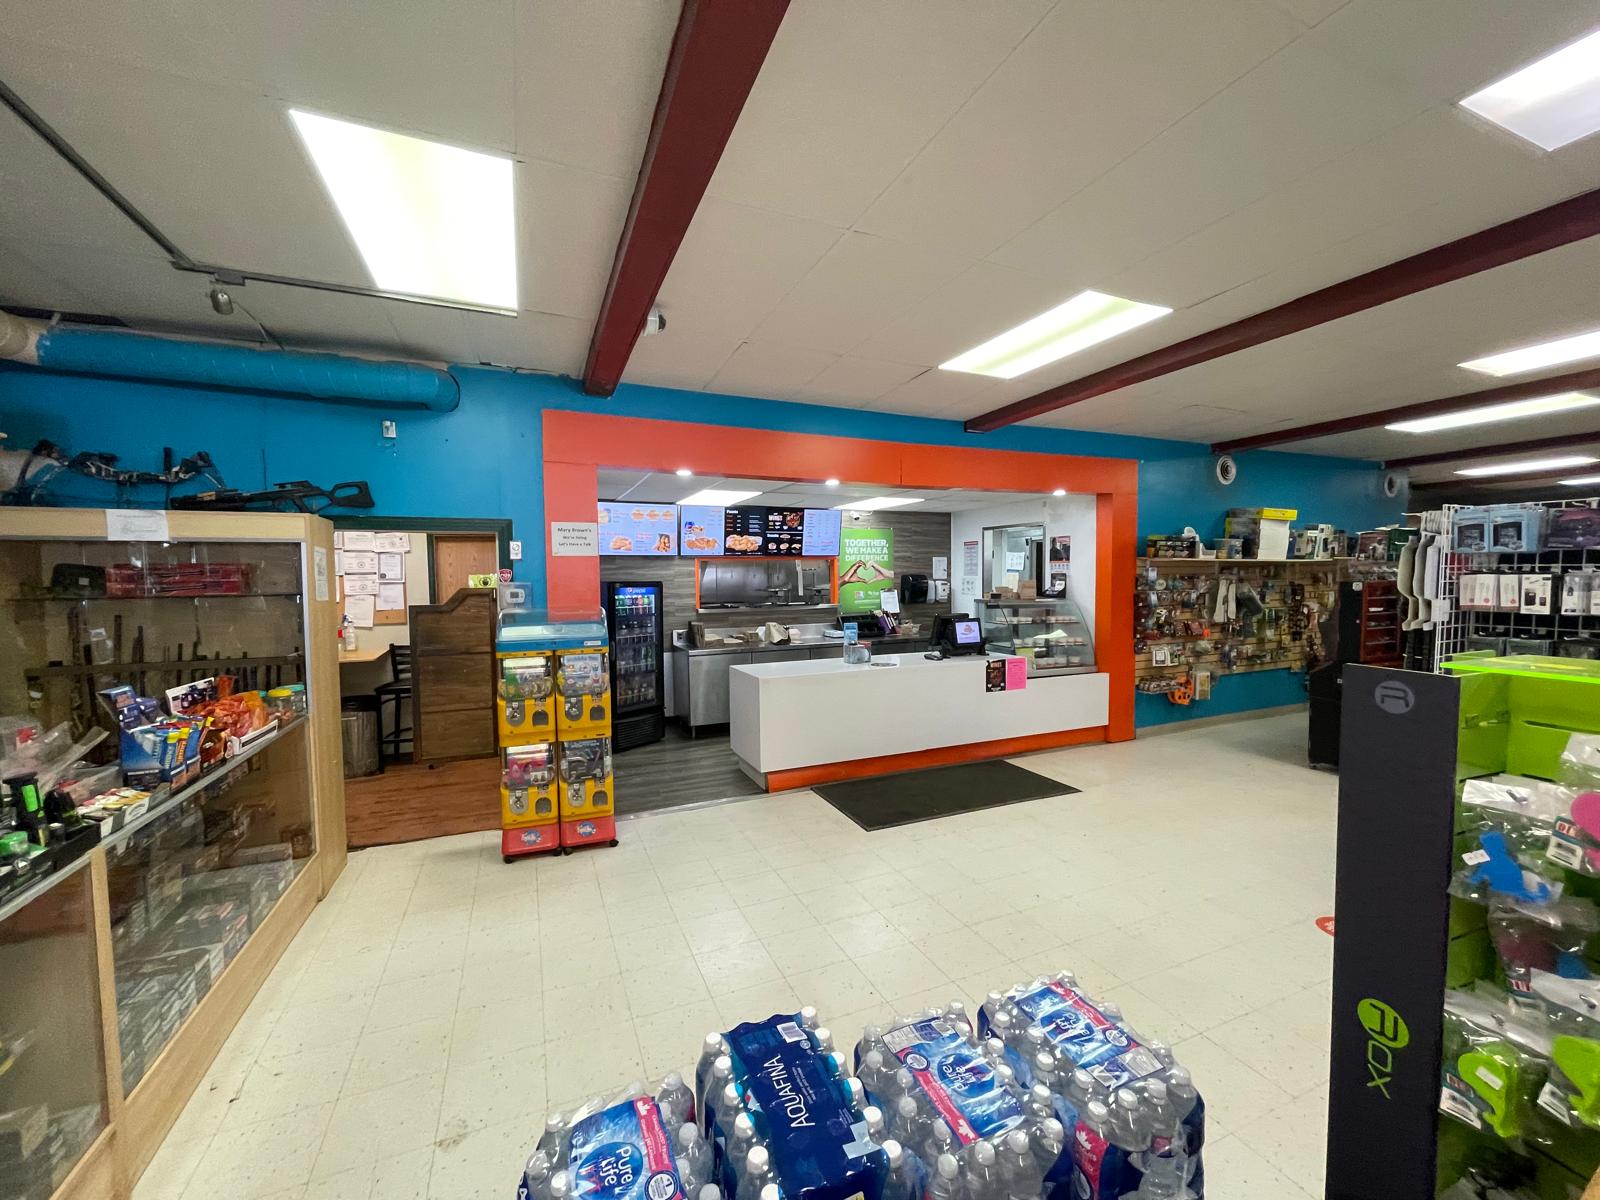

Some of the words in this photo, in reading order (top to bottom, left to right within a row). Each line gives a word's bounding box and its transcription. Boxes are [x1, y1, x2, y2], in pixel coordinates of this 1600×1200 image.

[844, 538, 889, 548] TOGETHER,
[882, 546, 888, 554] A
[845, 554, 889, 562] DIFFERENCE
[763, 1053, 816, 1128] AQUAFINA
[600, 1157, 620, 1186] Life
[615, 1146, 634, 1185] Pure
